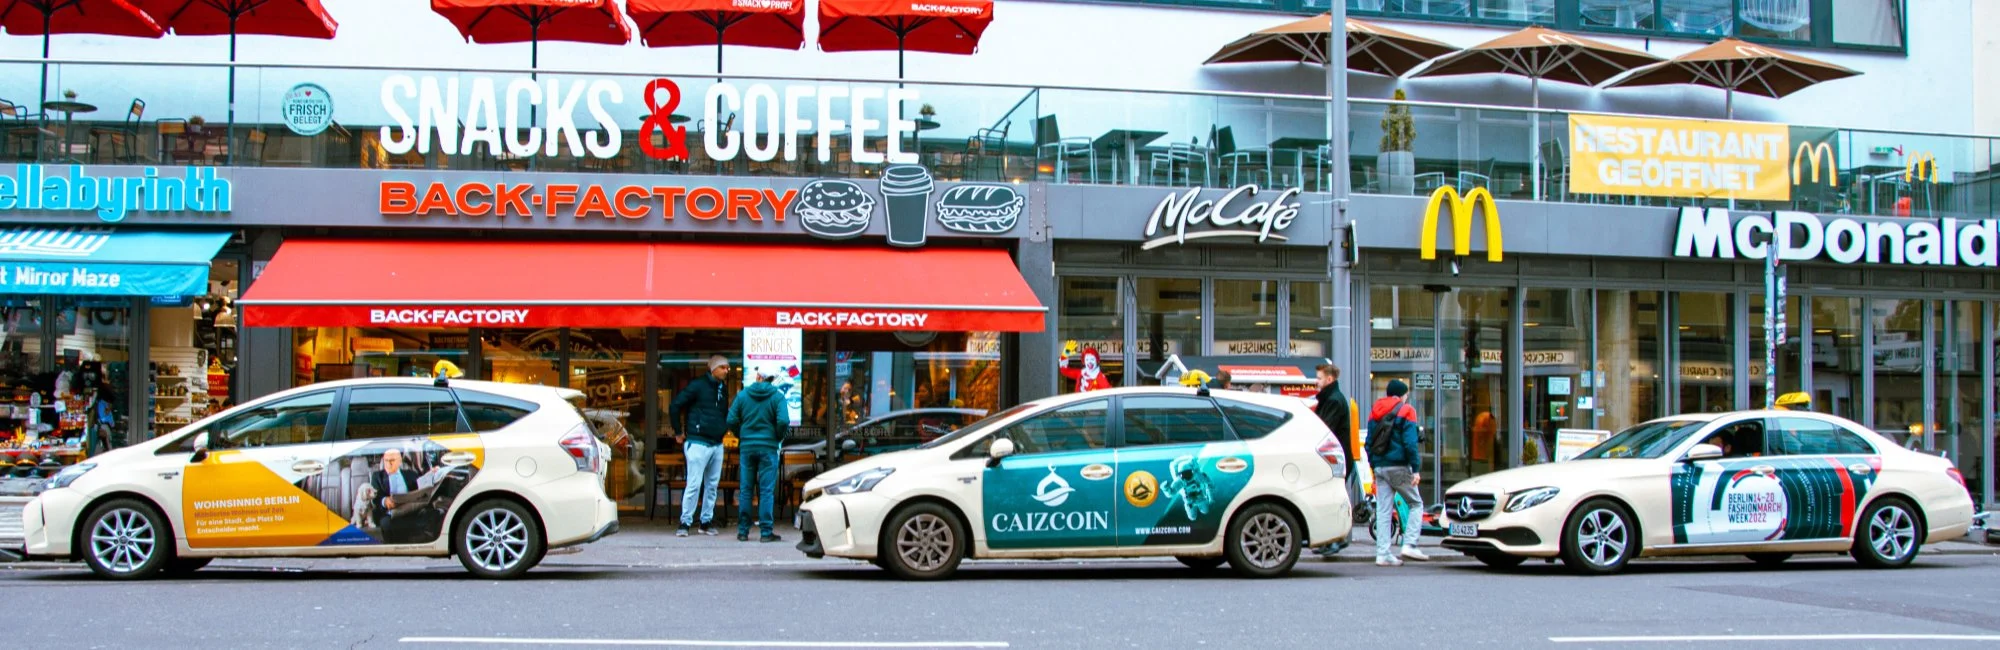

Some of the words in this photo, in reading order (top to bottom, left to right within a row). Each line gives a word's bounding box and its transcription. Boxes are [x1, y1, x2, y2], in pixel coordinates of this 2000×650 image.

[289, 104, 326, 116] FRISCH
[293, 115, 322, 125] BELEGT
[380, 74, 623, 159] SNACKS
[639, 78, 689, 161] &
[703, 82, 919, 164] COFFEE
[1574, 124, 1784, 161] RESTAURANT
[1598, 156, 1762, 191] GEÖFFNET
[0, 163, 231, 222] ellabyrinth
[1146, 184, 1301, 244] McCafé
[1675, 207, 2000, 267] McDonald
[15, 266, 67, 286] Mirror
[72, 268, 120, 287] Maze
[750, 337, 793, 353] BRINGER
[194, 497, 262, 510] WOHNSINNIG
[264, 495, 300, 505] BERLIN
[992, 511, 1109, 532] CAIZCOIN
[1135, 526, 1191, 535] WWW.CAIZCOIN.COM
